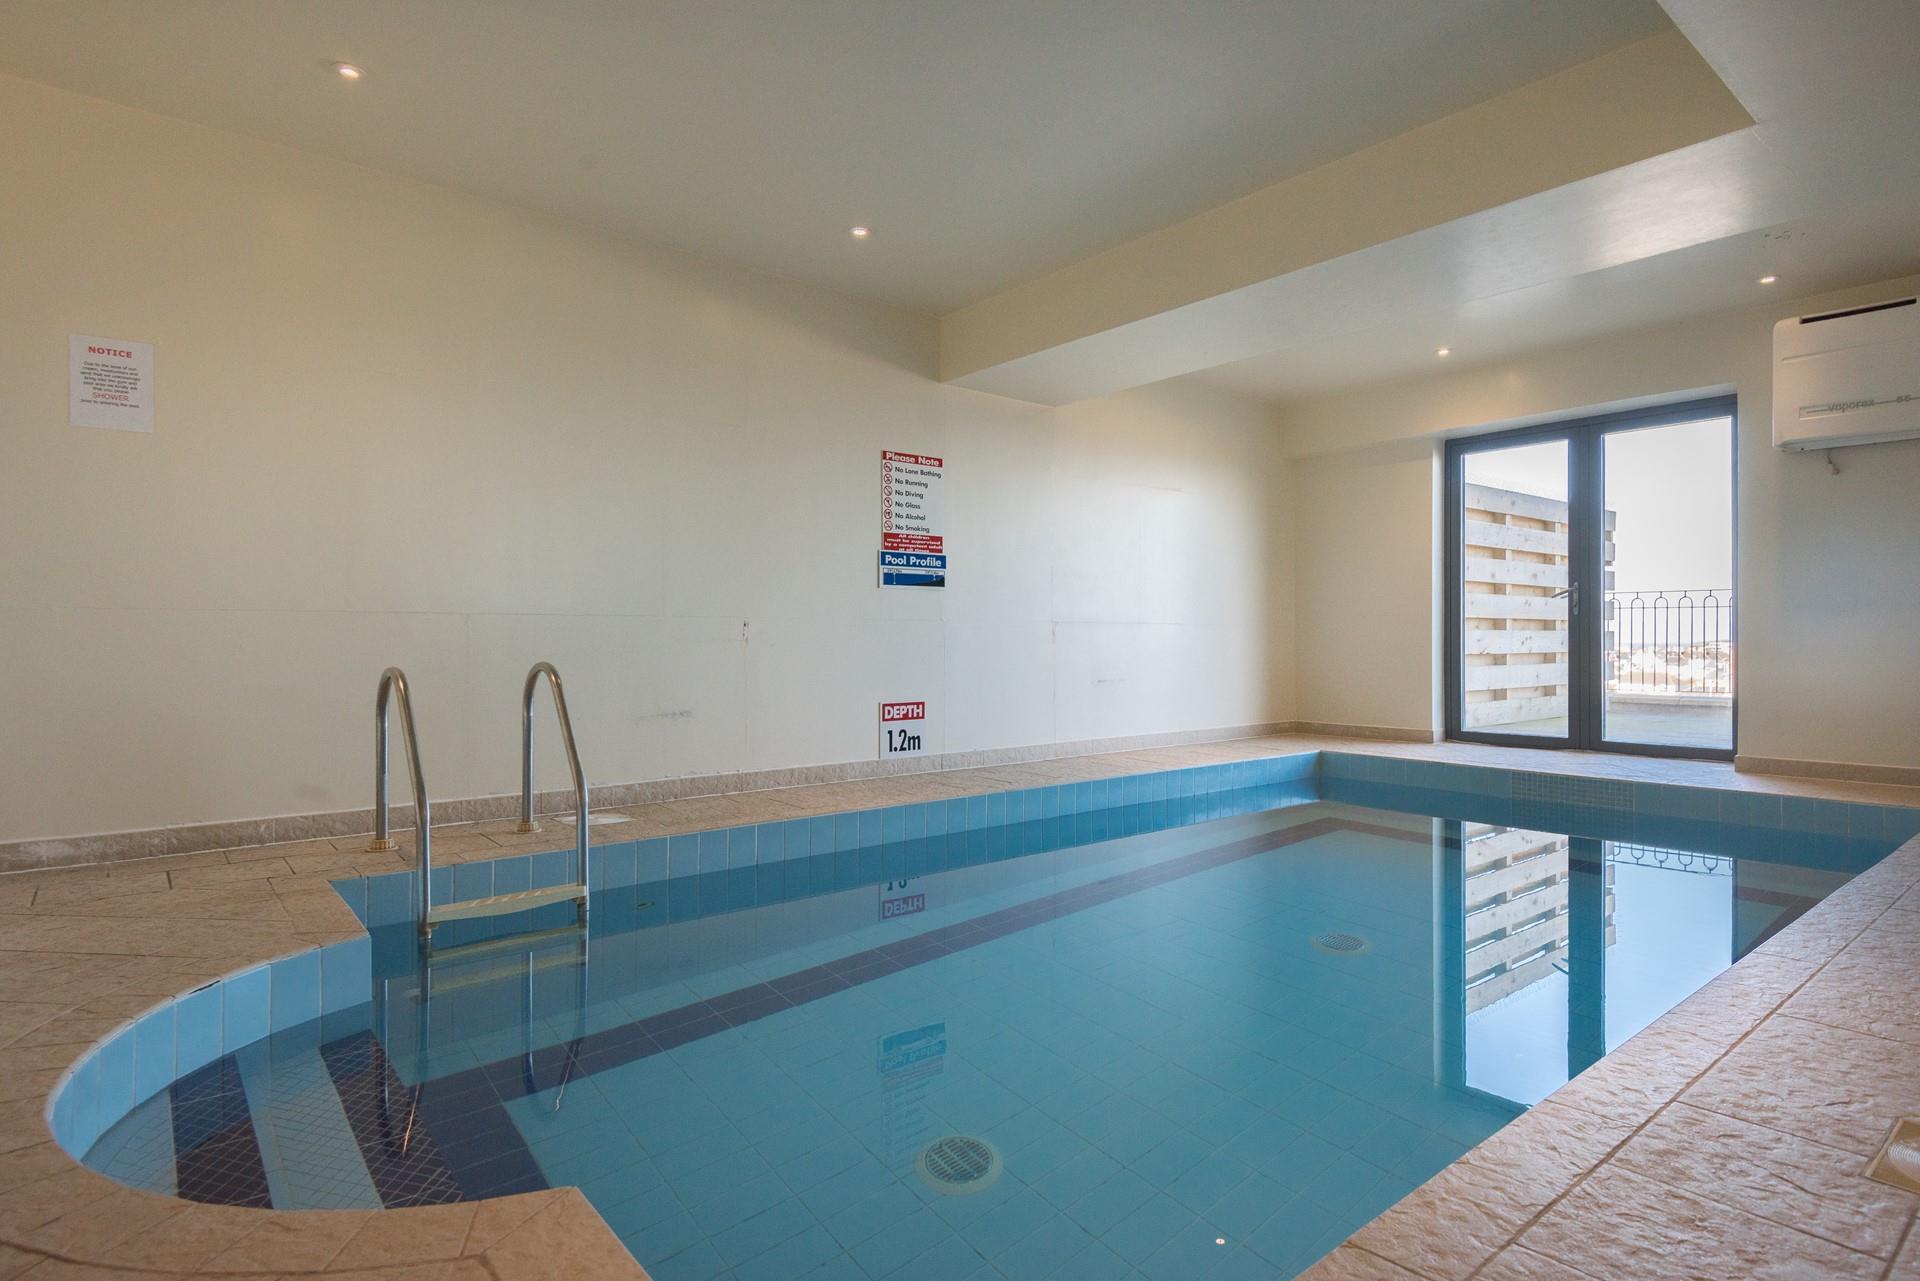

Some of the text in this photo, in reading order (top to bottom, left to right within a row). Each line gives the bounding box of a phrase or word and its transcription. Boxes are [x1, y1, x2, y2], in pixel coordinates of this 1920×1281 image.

[88, 346, 132, 358] NOTICE
[92, 392, 129, 401] SHOWER
[886, 452, 940, 466] Please Note
[920, 470, 941, 479] Bathing
[905, 479, 928, 488] Running
[905, 491, 923, 499] Diving
[885, 554, 942, 567] Pool Profile
[885, 705, 922, 719] DEPTH
[888, 729, 920, 752] 1.2m
